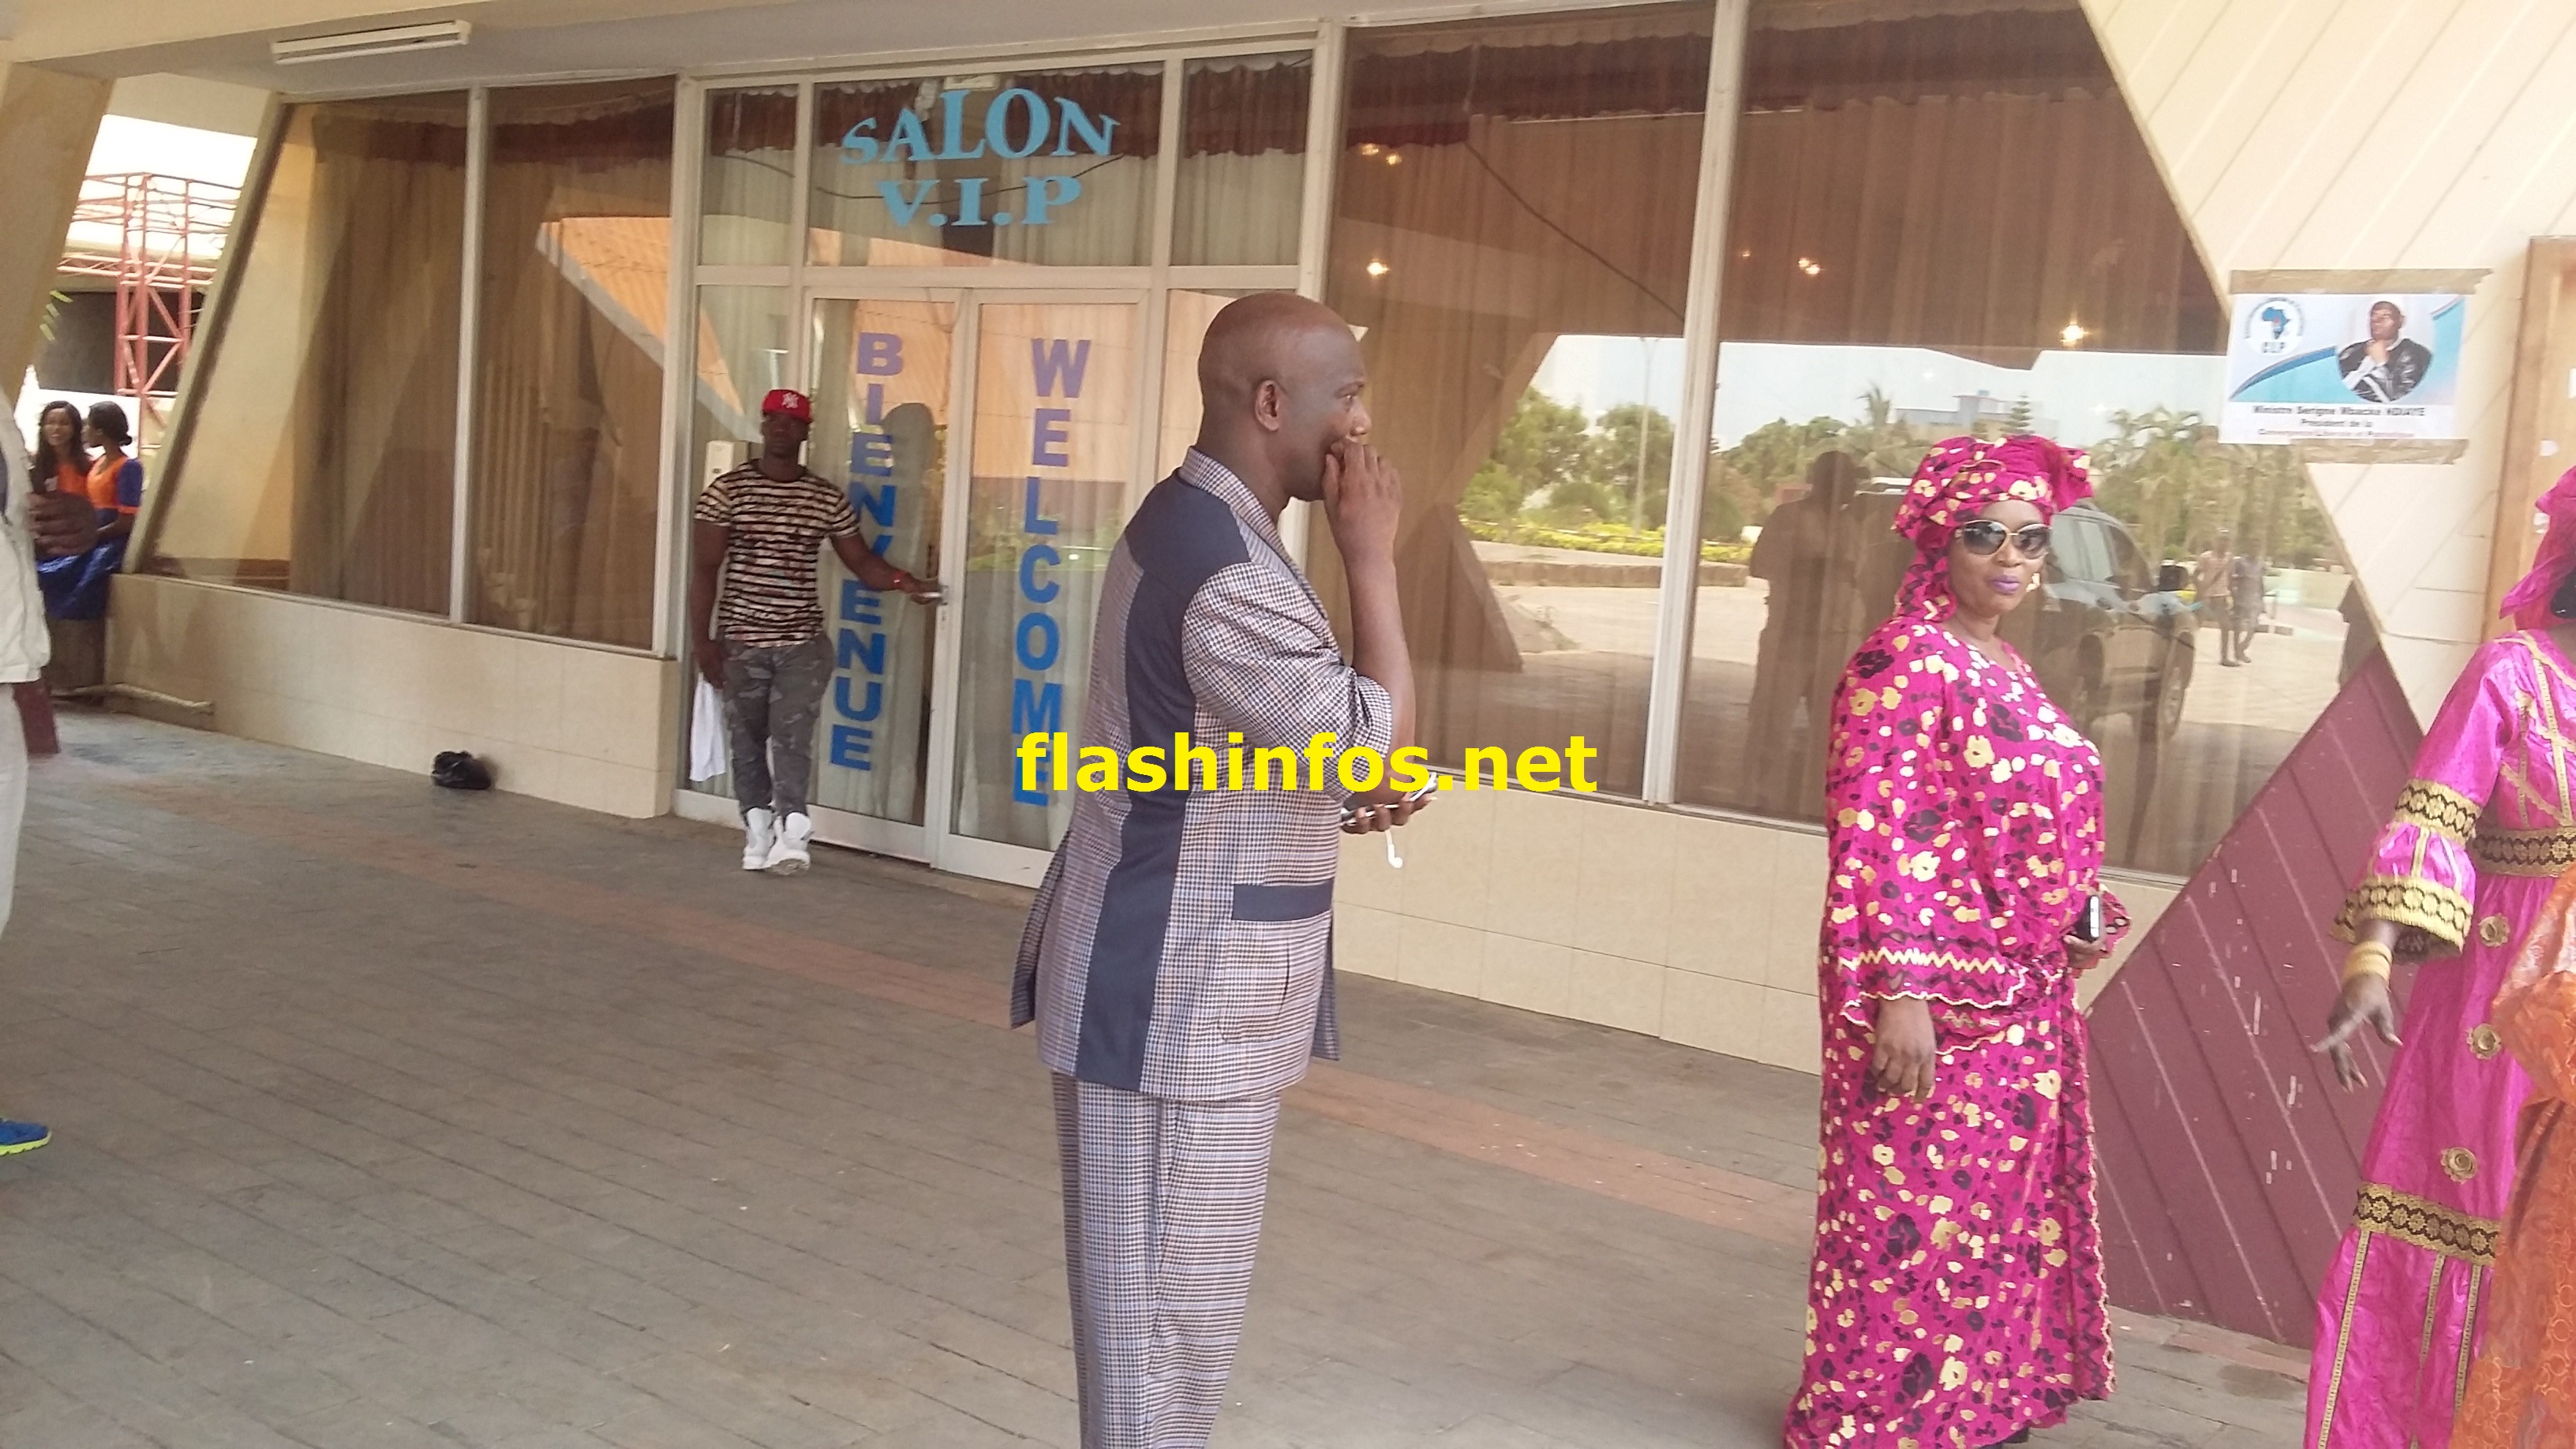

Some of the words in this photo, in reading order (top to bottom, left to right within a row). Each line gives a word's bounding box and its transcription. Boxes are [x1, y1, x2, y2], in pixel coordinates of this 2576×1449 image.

[840, 88, 1121, 163] SALON
[877, 175, 1081, 227] V.I.P
[829, 331, 904, 771] BIENENUE
